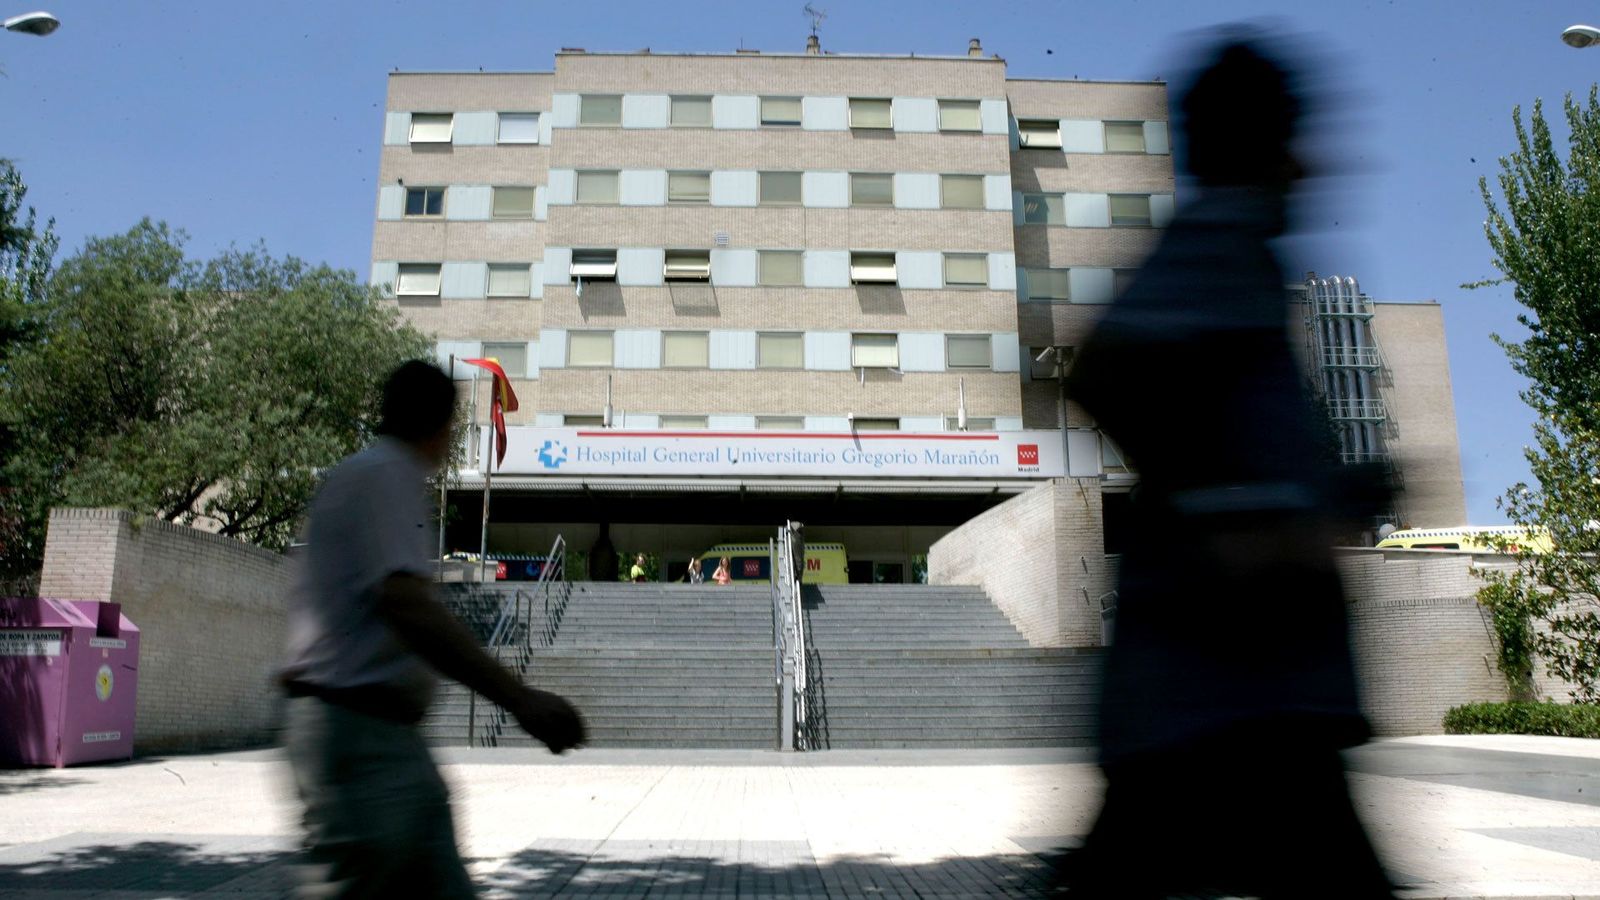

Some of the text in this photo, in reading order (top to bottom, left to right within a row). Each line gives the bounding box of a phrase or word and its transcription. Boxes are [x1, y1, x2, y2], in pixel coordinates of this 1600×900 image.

[577, 446, 1000, 468] Hospital General Universitario Gregorio Marañón
[9, 633, 25, 641] ROPA
[32, 633, 60, 641] ZAPATOS
